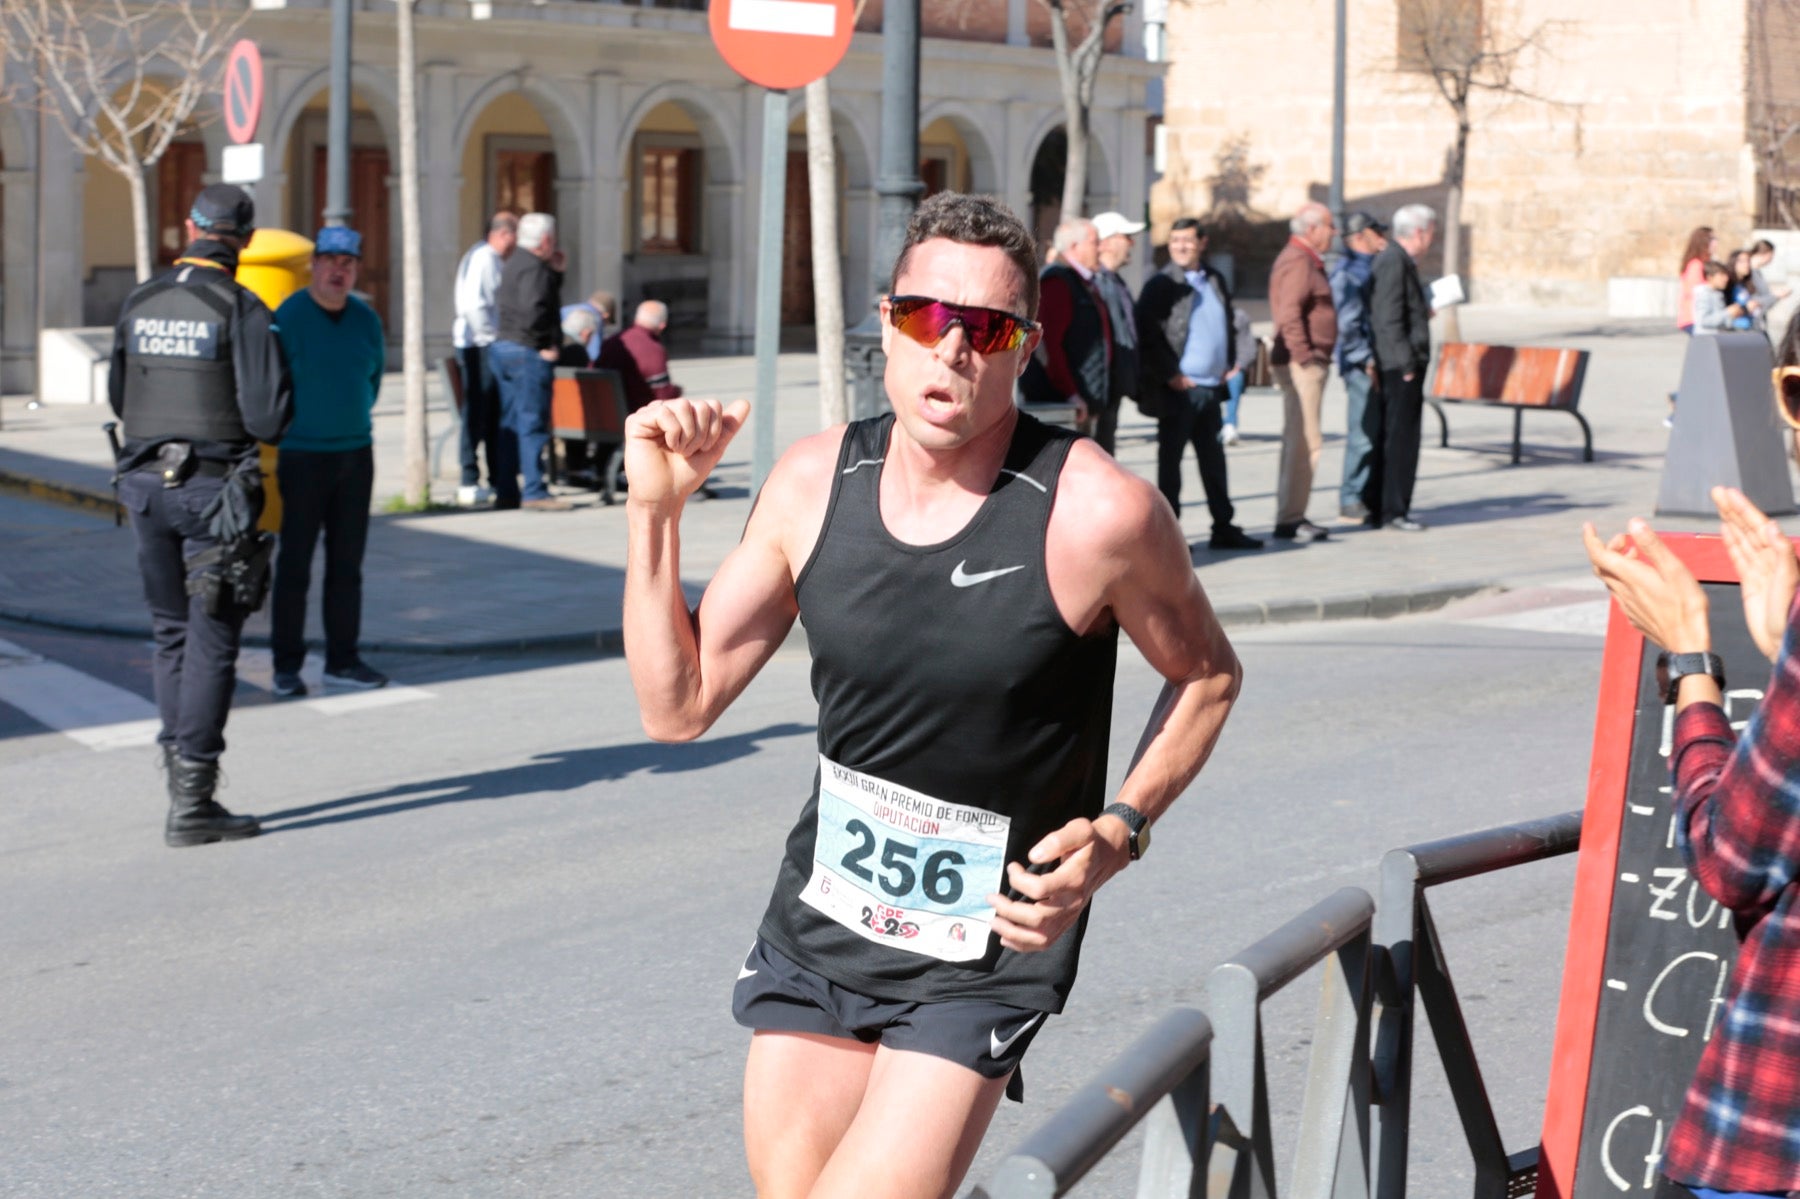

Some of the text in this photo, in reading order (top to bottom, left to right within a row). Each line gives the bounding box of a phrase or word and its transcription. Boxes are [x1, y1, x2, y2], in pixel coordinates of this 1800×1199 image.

[134, 318, 209, 339] POLICIA
[138, 336, 201, 356] LOCAL
[861, 779, 888, 803] GRAN
[891, 791, 933, 818] PREMIO
[936, 806, 952, 821] DE
[956, 810, 997, 826] FONDO
[841, 818, 966, 904] 256
[1648, 867, 1732, 929] ZU
